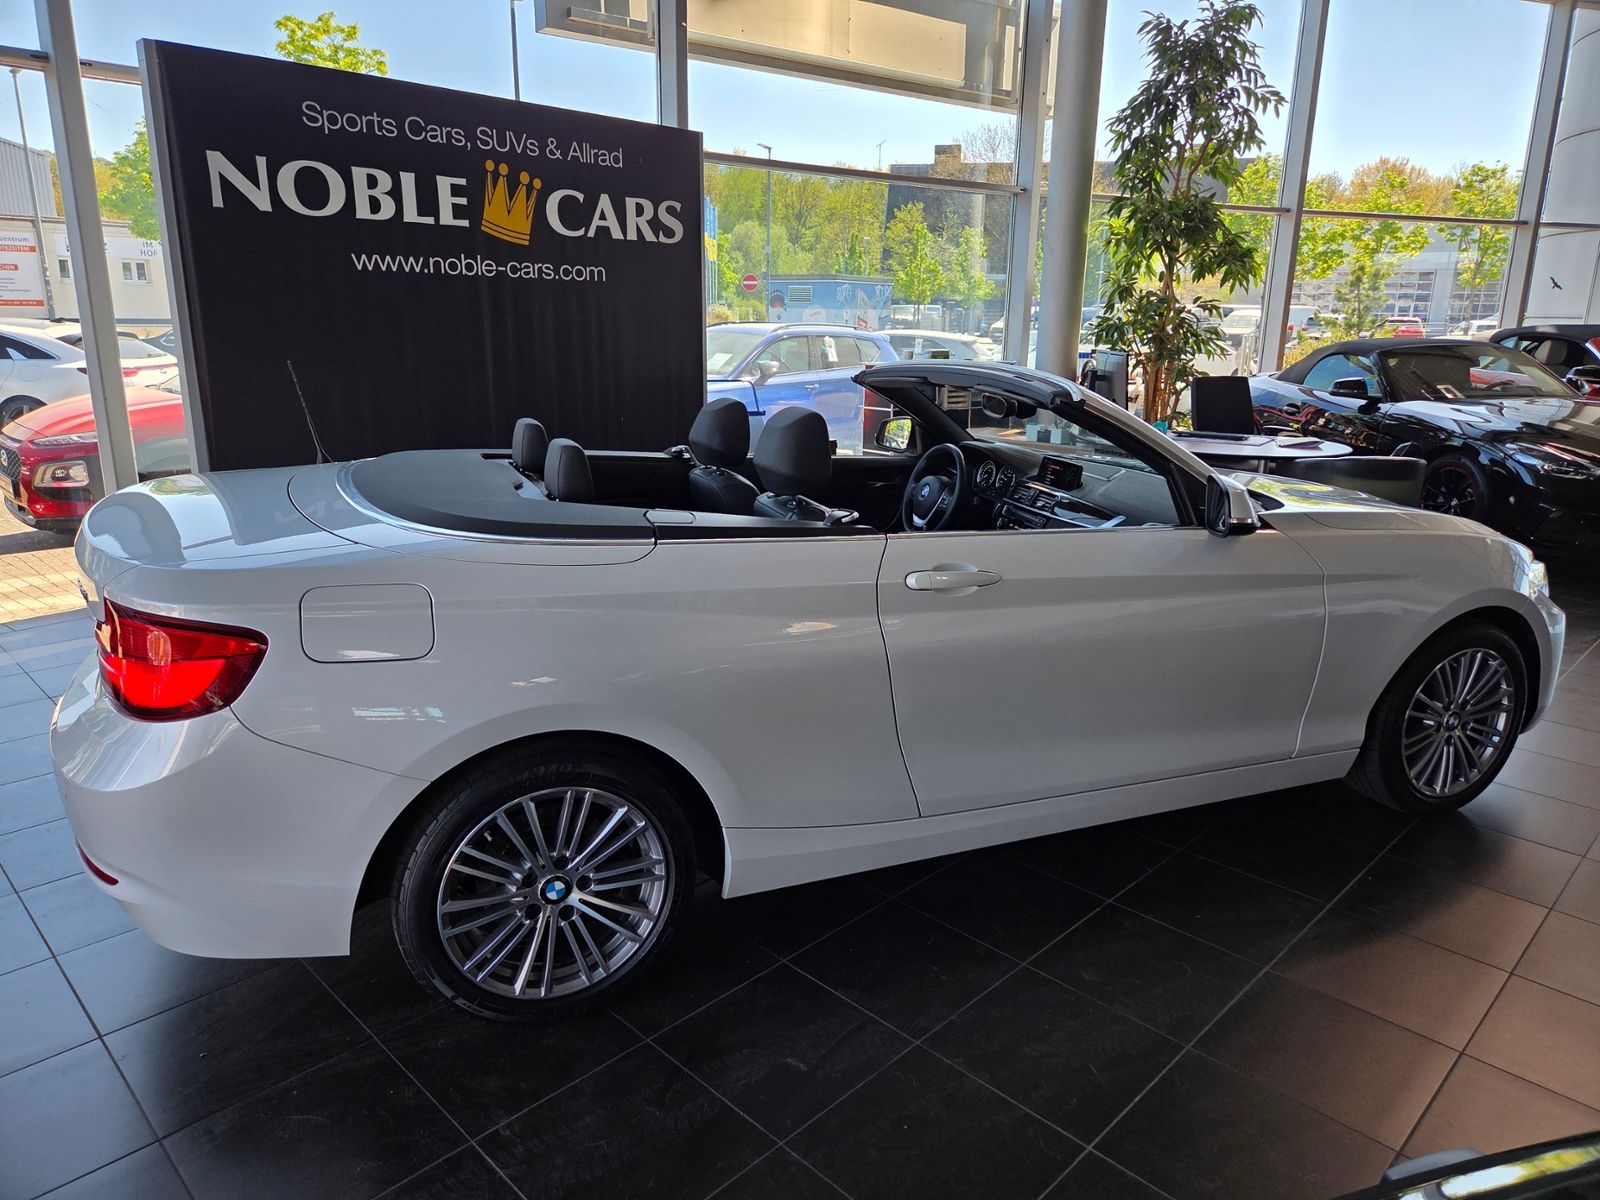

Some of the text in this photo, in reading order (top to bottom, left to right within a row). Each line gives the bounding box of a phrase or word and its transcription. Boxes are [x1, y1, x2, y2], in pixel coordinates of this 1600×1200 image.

[301, 100, 624, 168] Sports Cars, SUVs & Allrad
[205, 149, 684, 244] NOBLE CARS
[140, 249, 158, 257] HOF
[350, 253, 606, 282] www.noble-cars.com
